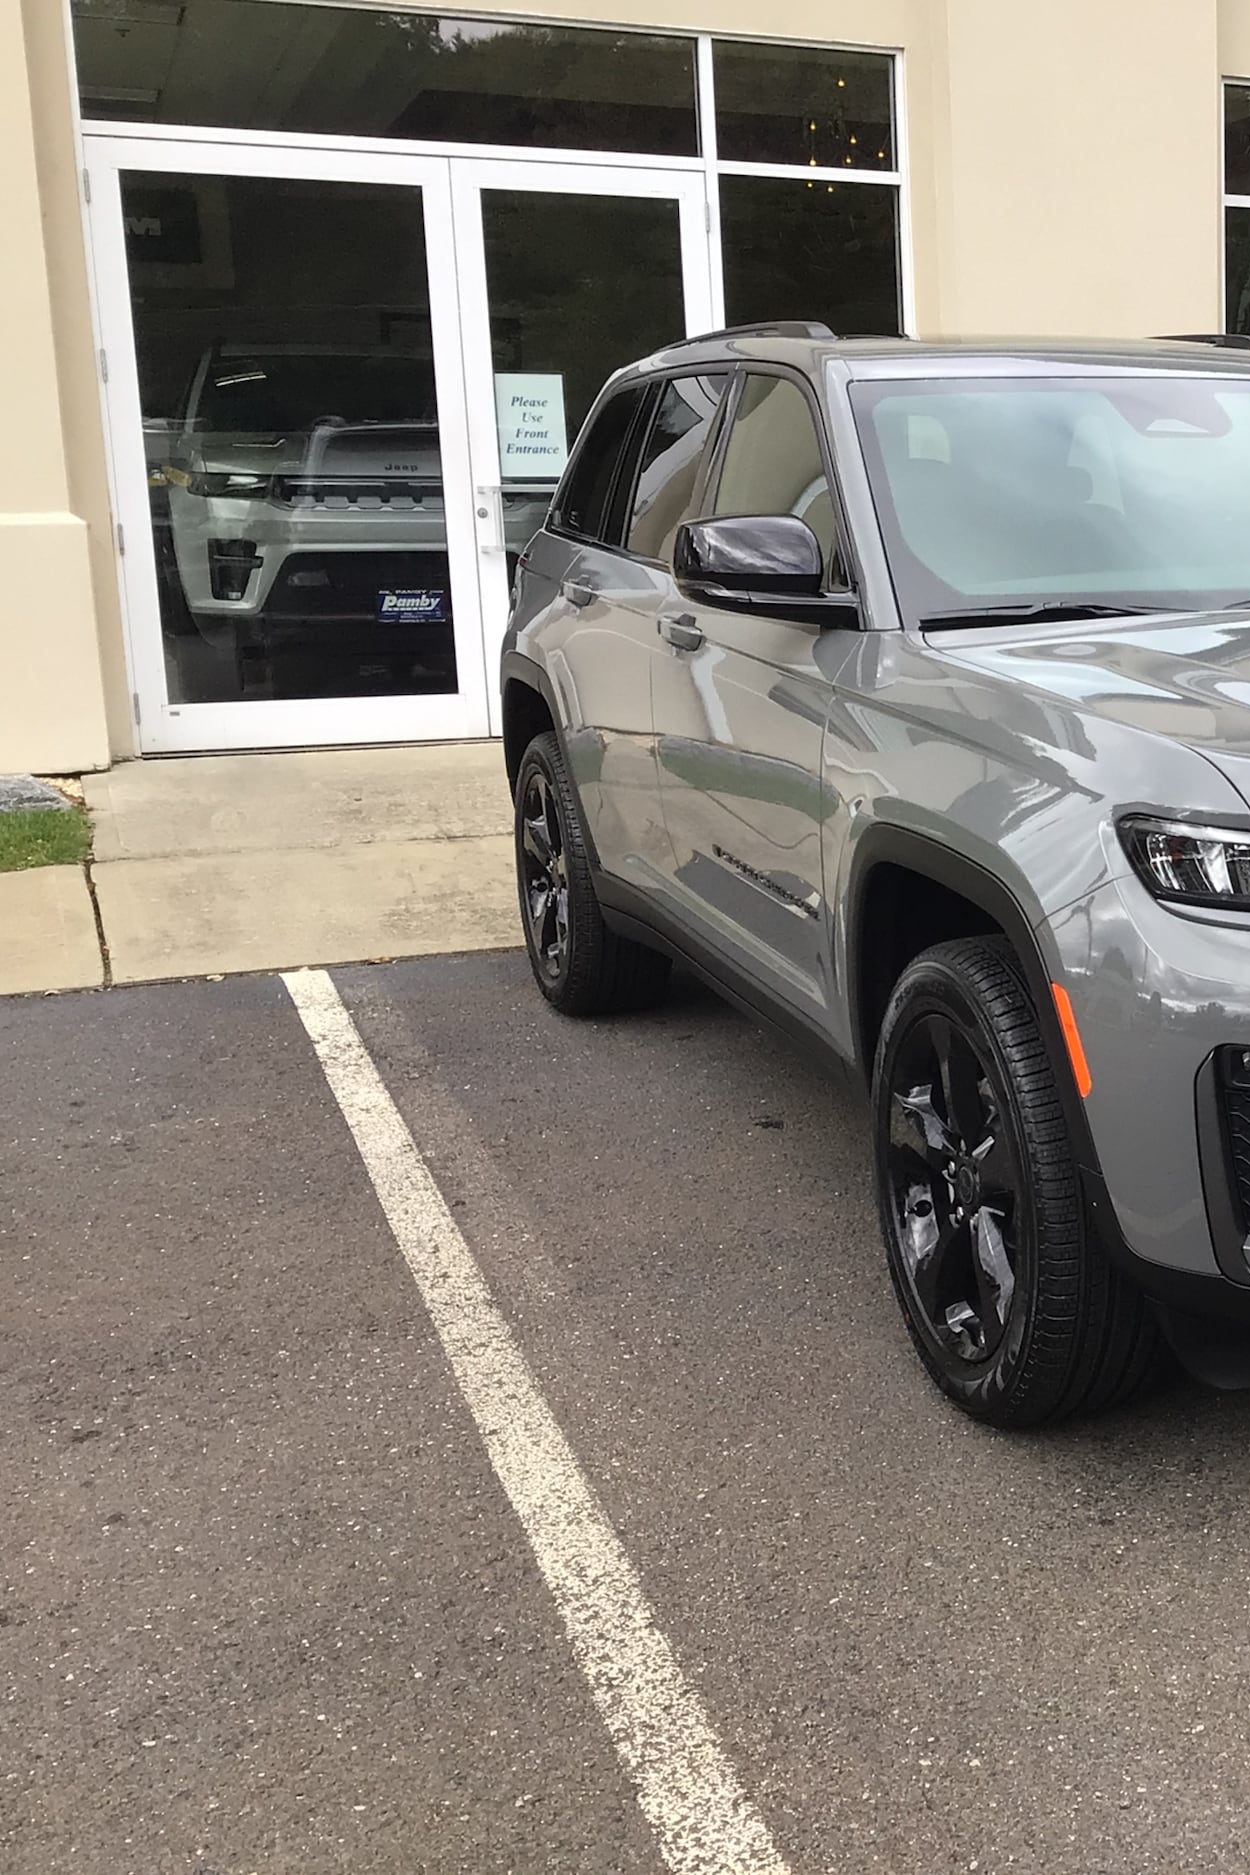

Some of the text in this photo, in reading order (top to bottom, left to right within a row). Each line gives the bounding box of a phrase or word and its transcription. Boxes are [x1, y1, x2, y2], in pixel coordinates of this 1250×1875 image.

[510, 395, 548, 408] Please
[521, 412, 543, 423] Use
[515, 428, 549, 439] Front
[506, 443, 560, 455] Entrance
[381, 595, 441, 612] Pamby
